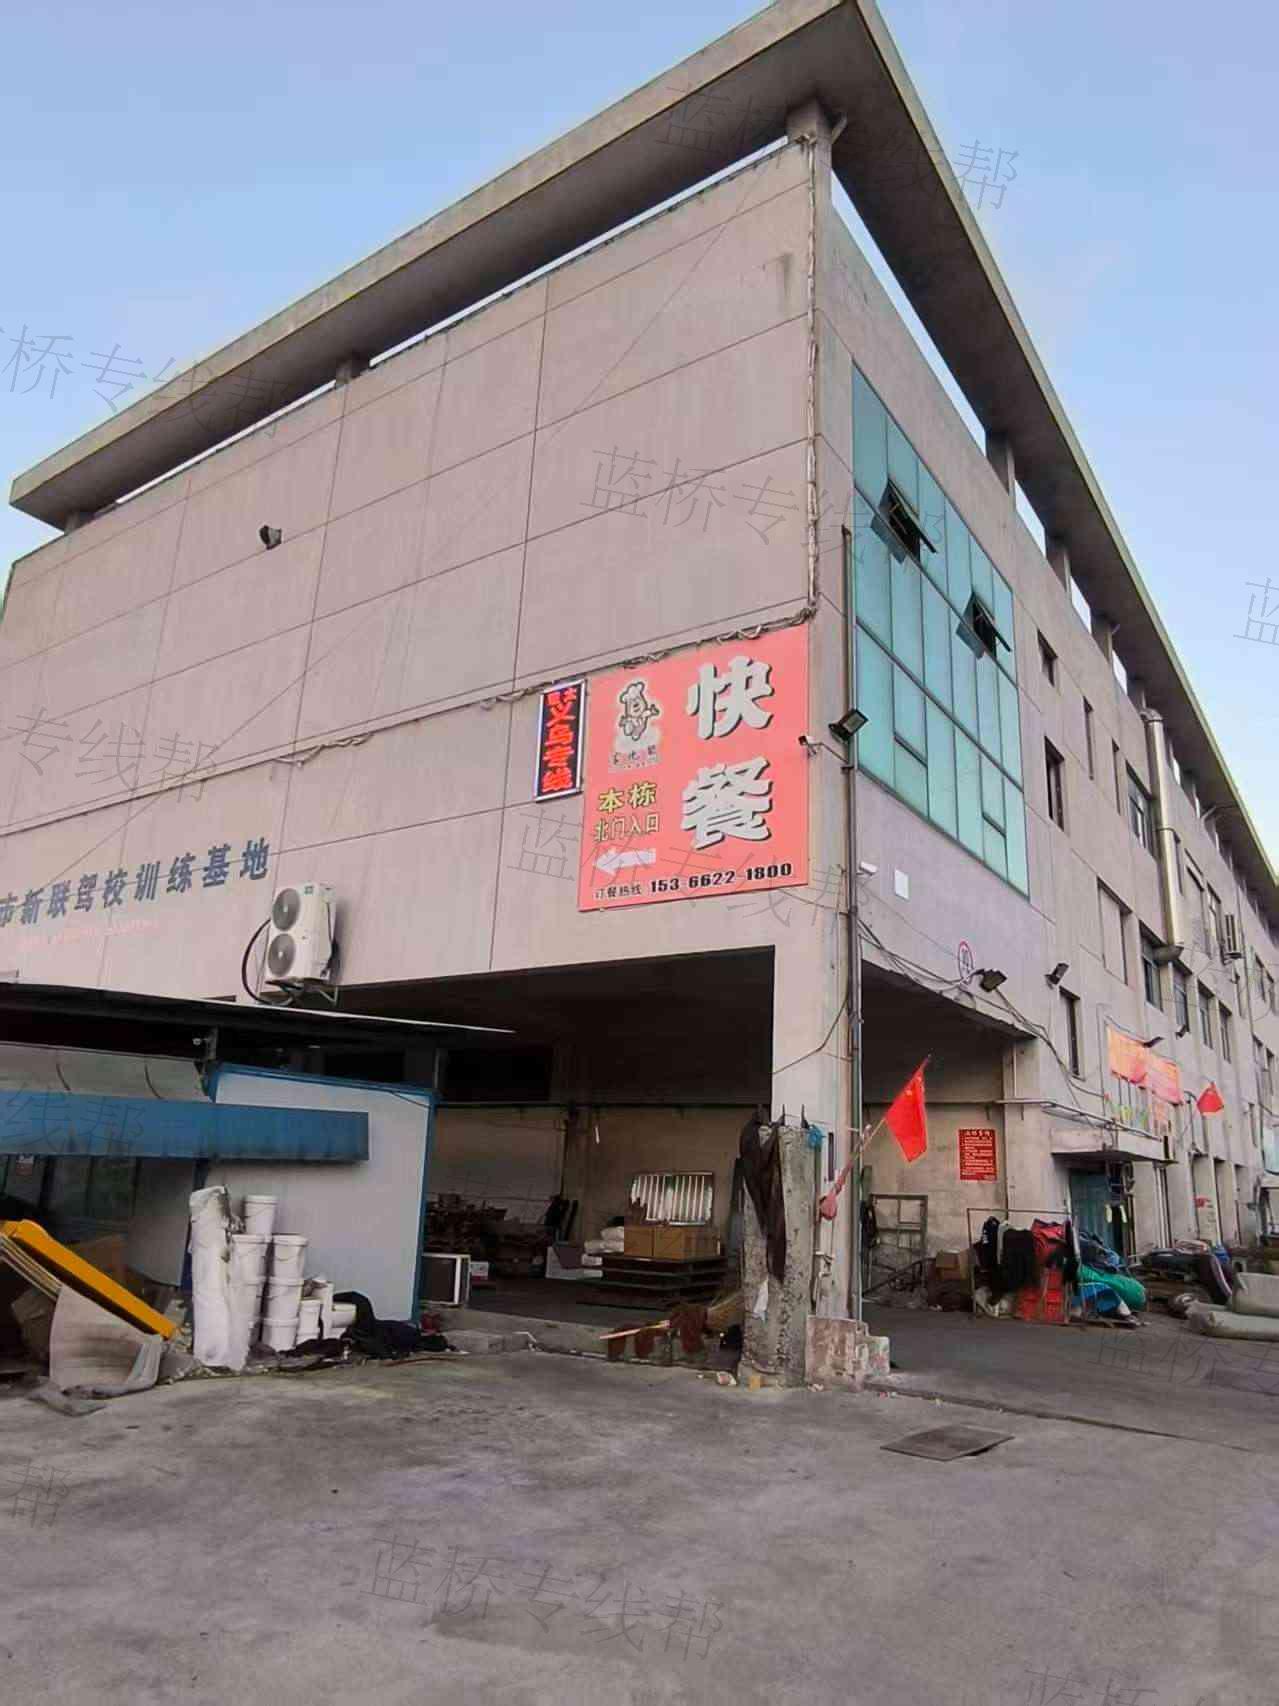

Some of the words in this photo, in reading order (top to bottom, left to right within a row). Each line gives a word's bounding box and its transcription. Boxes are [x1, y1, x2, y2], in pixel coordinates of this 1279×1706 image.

[680, 655, 775, 850] 快餐
[599, 781, 657, 815] 本栋
[593, 812, 660, 844] 北门入口
[0, 836, 271, 928] 市新联驾校训练基地
[650, 878, 680, 893] 153
[688, 870, 736, 889] 6622
[745, 862, 793, 881] 1800
